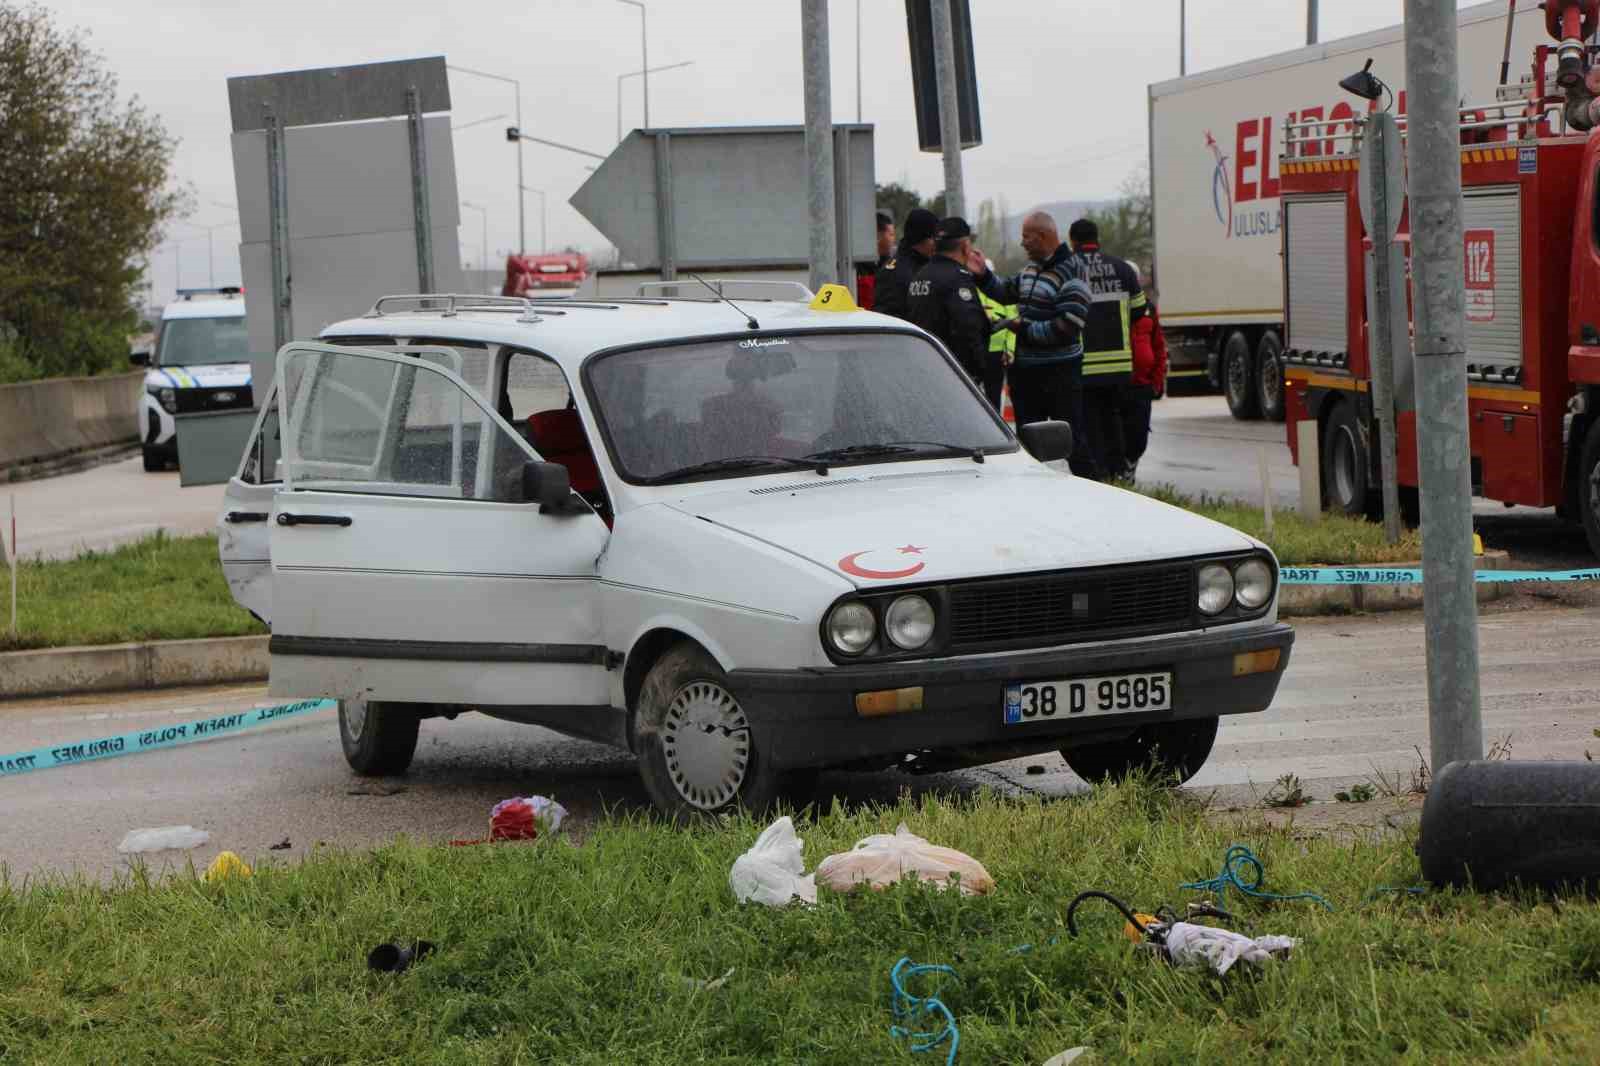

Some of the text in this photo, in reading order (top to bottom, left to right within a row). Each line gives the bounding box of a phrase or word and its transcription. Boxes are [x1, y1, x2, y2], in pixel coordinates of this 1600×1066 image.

[1467, 240, 1490, 282] 112
[821, 291, 833, 304] 3
[1022, 675, 1166, 717] 38 D 9985
[1009, 705, 1021, 717] TR
